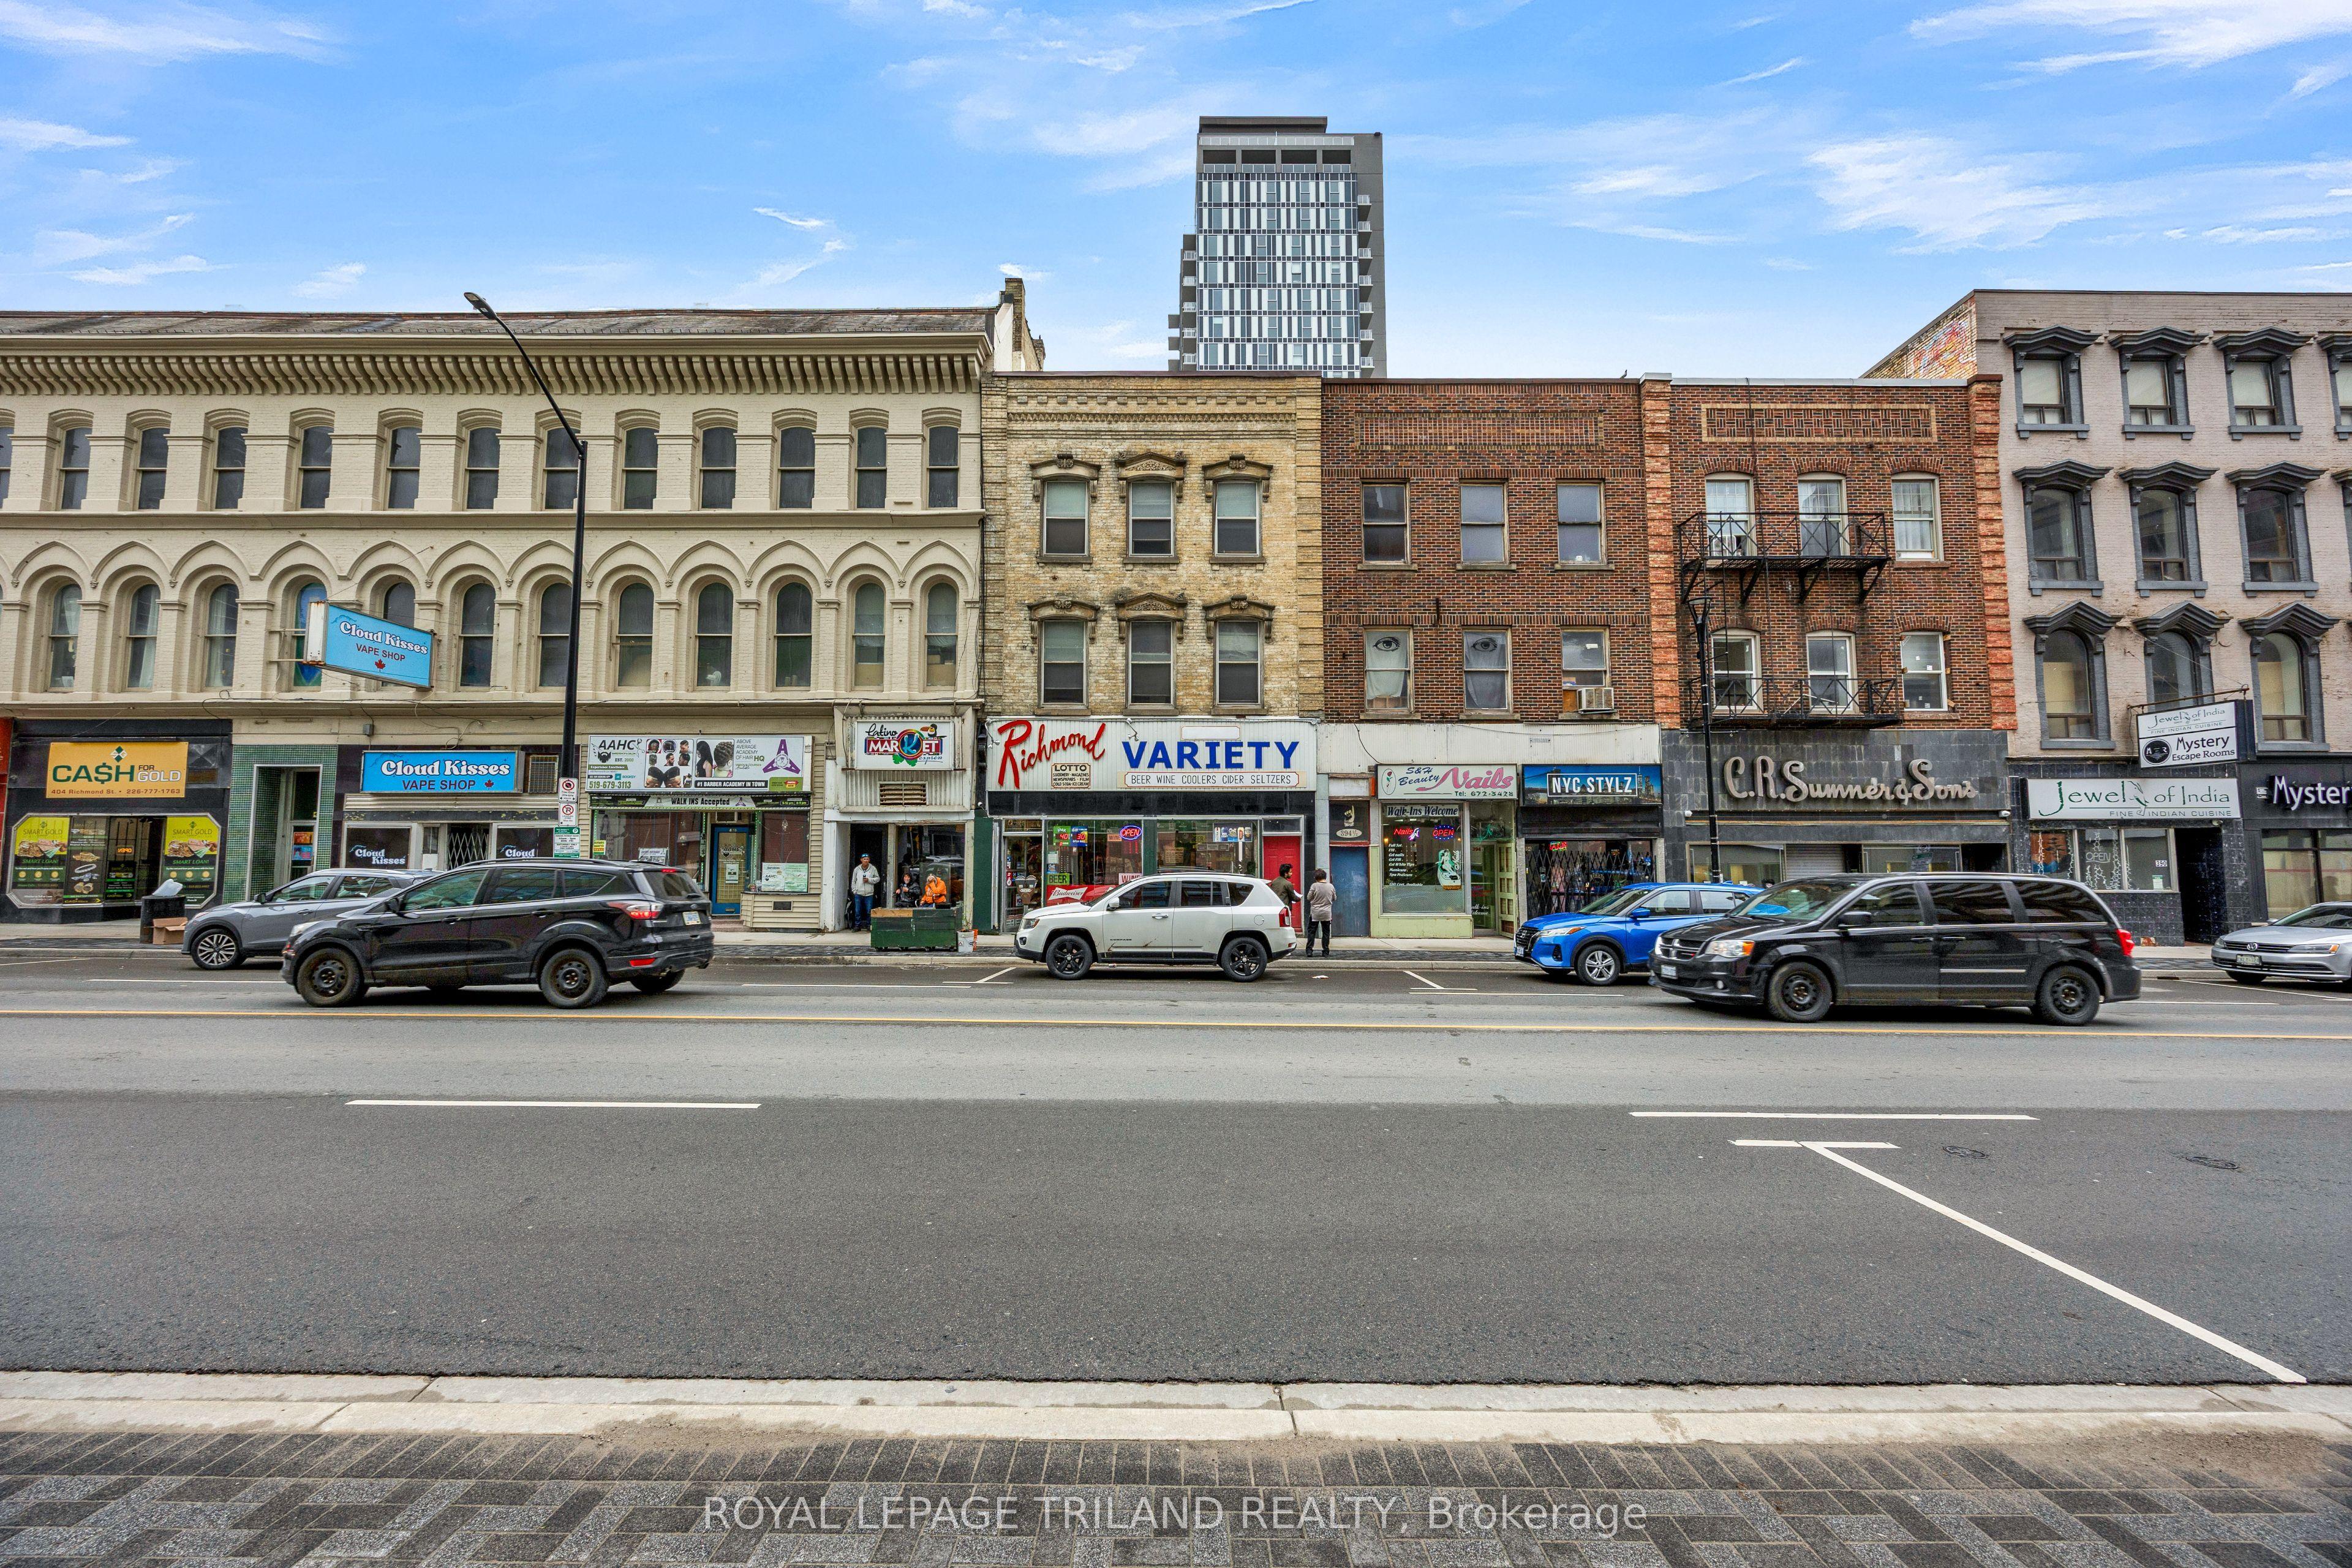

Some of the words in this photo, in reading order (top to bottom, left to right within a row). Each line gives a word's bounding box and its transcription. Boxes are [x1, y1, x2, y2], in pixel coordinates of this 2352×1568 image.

[339, 621, 383, 643] Cloud
[385, 633, 428, 654] Kisses
[356, 643, 379, 656] VAPE
[382, 650, 405, 662] SHOP
[2147, 712, 2182, 729] Jewel
[2192, 709, 2201, 718] of
[2203, 708, 2225, 718] India
[865, 723, 898, 737] Latino
[598, 739, 636, 750] AAHC
[869, 733, 940, 754] MARKET
[2176, 736, 2230, 752] Mystery
[919, 756, 943, 764] express
[997, 720, 1106, 790] Richmond
[1121, 741, 1300, 769] VARIETY
[2203, 749, 2235, 758] Rooms
[52, 762, 135, 785] CA$H
[137, 770, 182, 782] GOLD
[381, 760, 440, 776] Cloud
[443, 760, 510, 776] Kisses
[402, 780, 435, 790] VAPE
[440, 780, 476, 790] SHOP
[1131, 775, 1151, 785] BEER
[1156, 775, 1175, 785] WINE
[1182, 774, 1216, 785] COOLERS
[1222, 774, 1245, 785] CIDER
[1251, 774, 1291, 785] SELTZERS
[1398, 774, 1440, 786] Beauty
[1415, 767, 1514, 791] Nails
[1552, 777, 1580, 793] NYC
[1587, 777, 1632, 793] STYLZ
[1781, 760, 1894, 802] Sumner
[1909, 758, 1978, 801] Sons
[2038, 780, 2126, 816] Jewel
[2154, 786, 2176, 803] of
[2182, 786, 2230, 805] India
[2273, 775, 2352, 811] Myster
[701, 797, 730, 806] Accepted
[1387, 806, 1422, 817] Walk-Ins
[1424, 806, 1458, 816] Welcome
[355, 849, 385, 858] Cloud
[2086, 852, 2111, 861] OPEN
[1049, 875, 1067, 884] BEER
